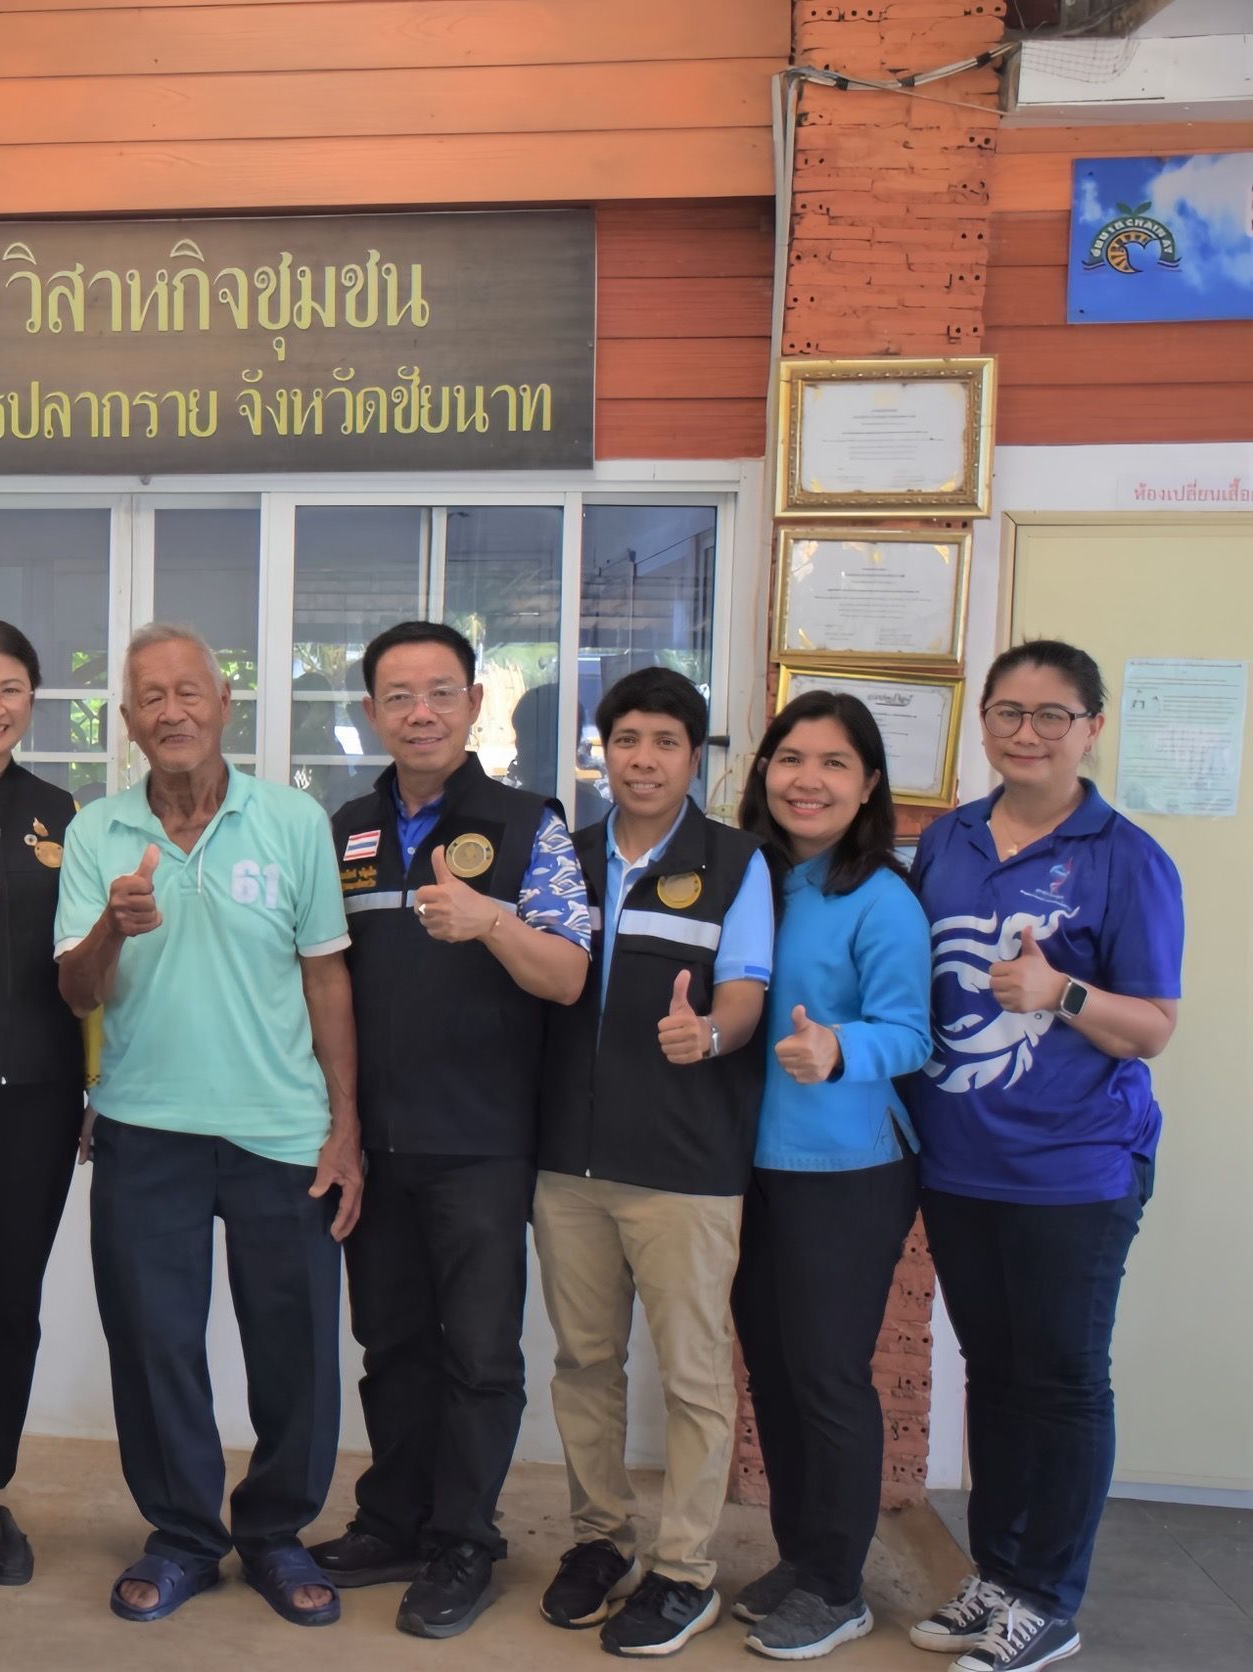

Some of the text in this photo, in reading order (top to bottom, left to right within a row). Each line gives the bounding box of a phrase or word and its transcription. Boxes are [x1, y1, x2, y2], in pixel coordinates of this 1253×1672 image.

[3, 238, 430, 361] วิสาหกิจชุมชน
[236, 365, 552, 436] จังหวัดชัยนาท
[231, 859, 279, 909] 61
